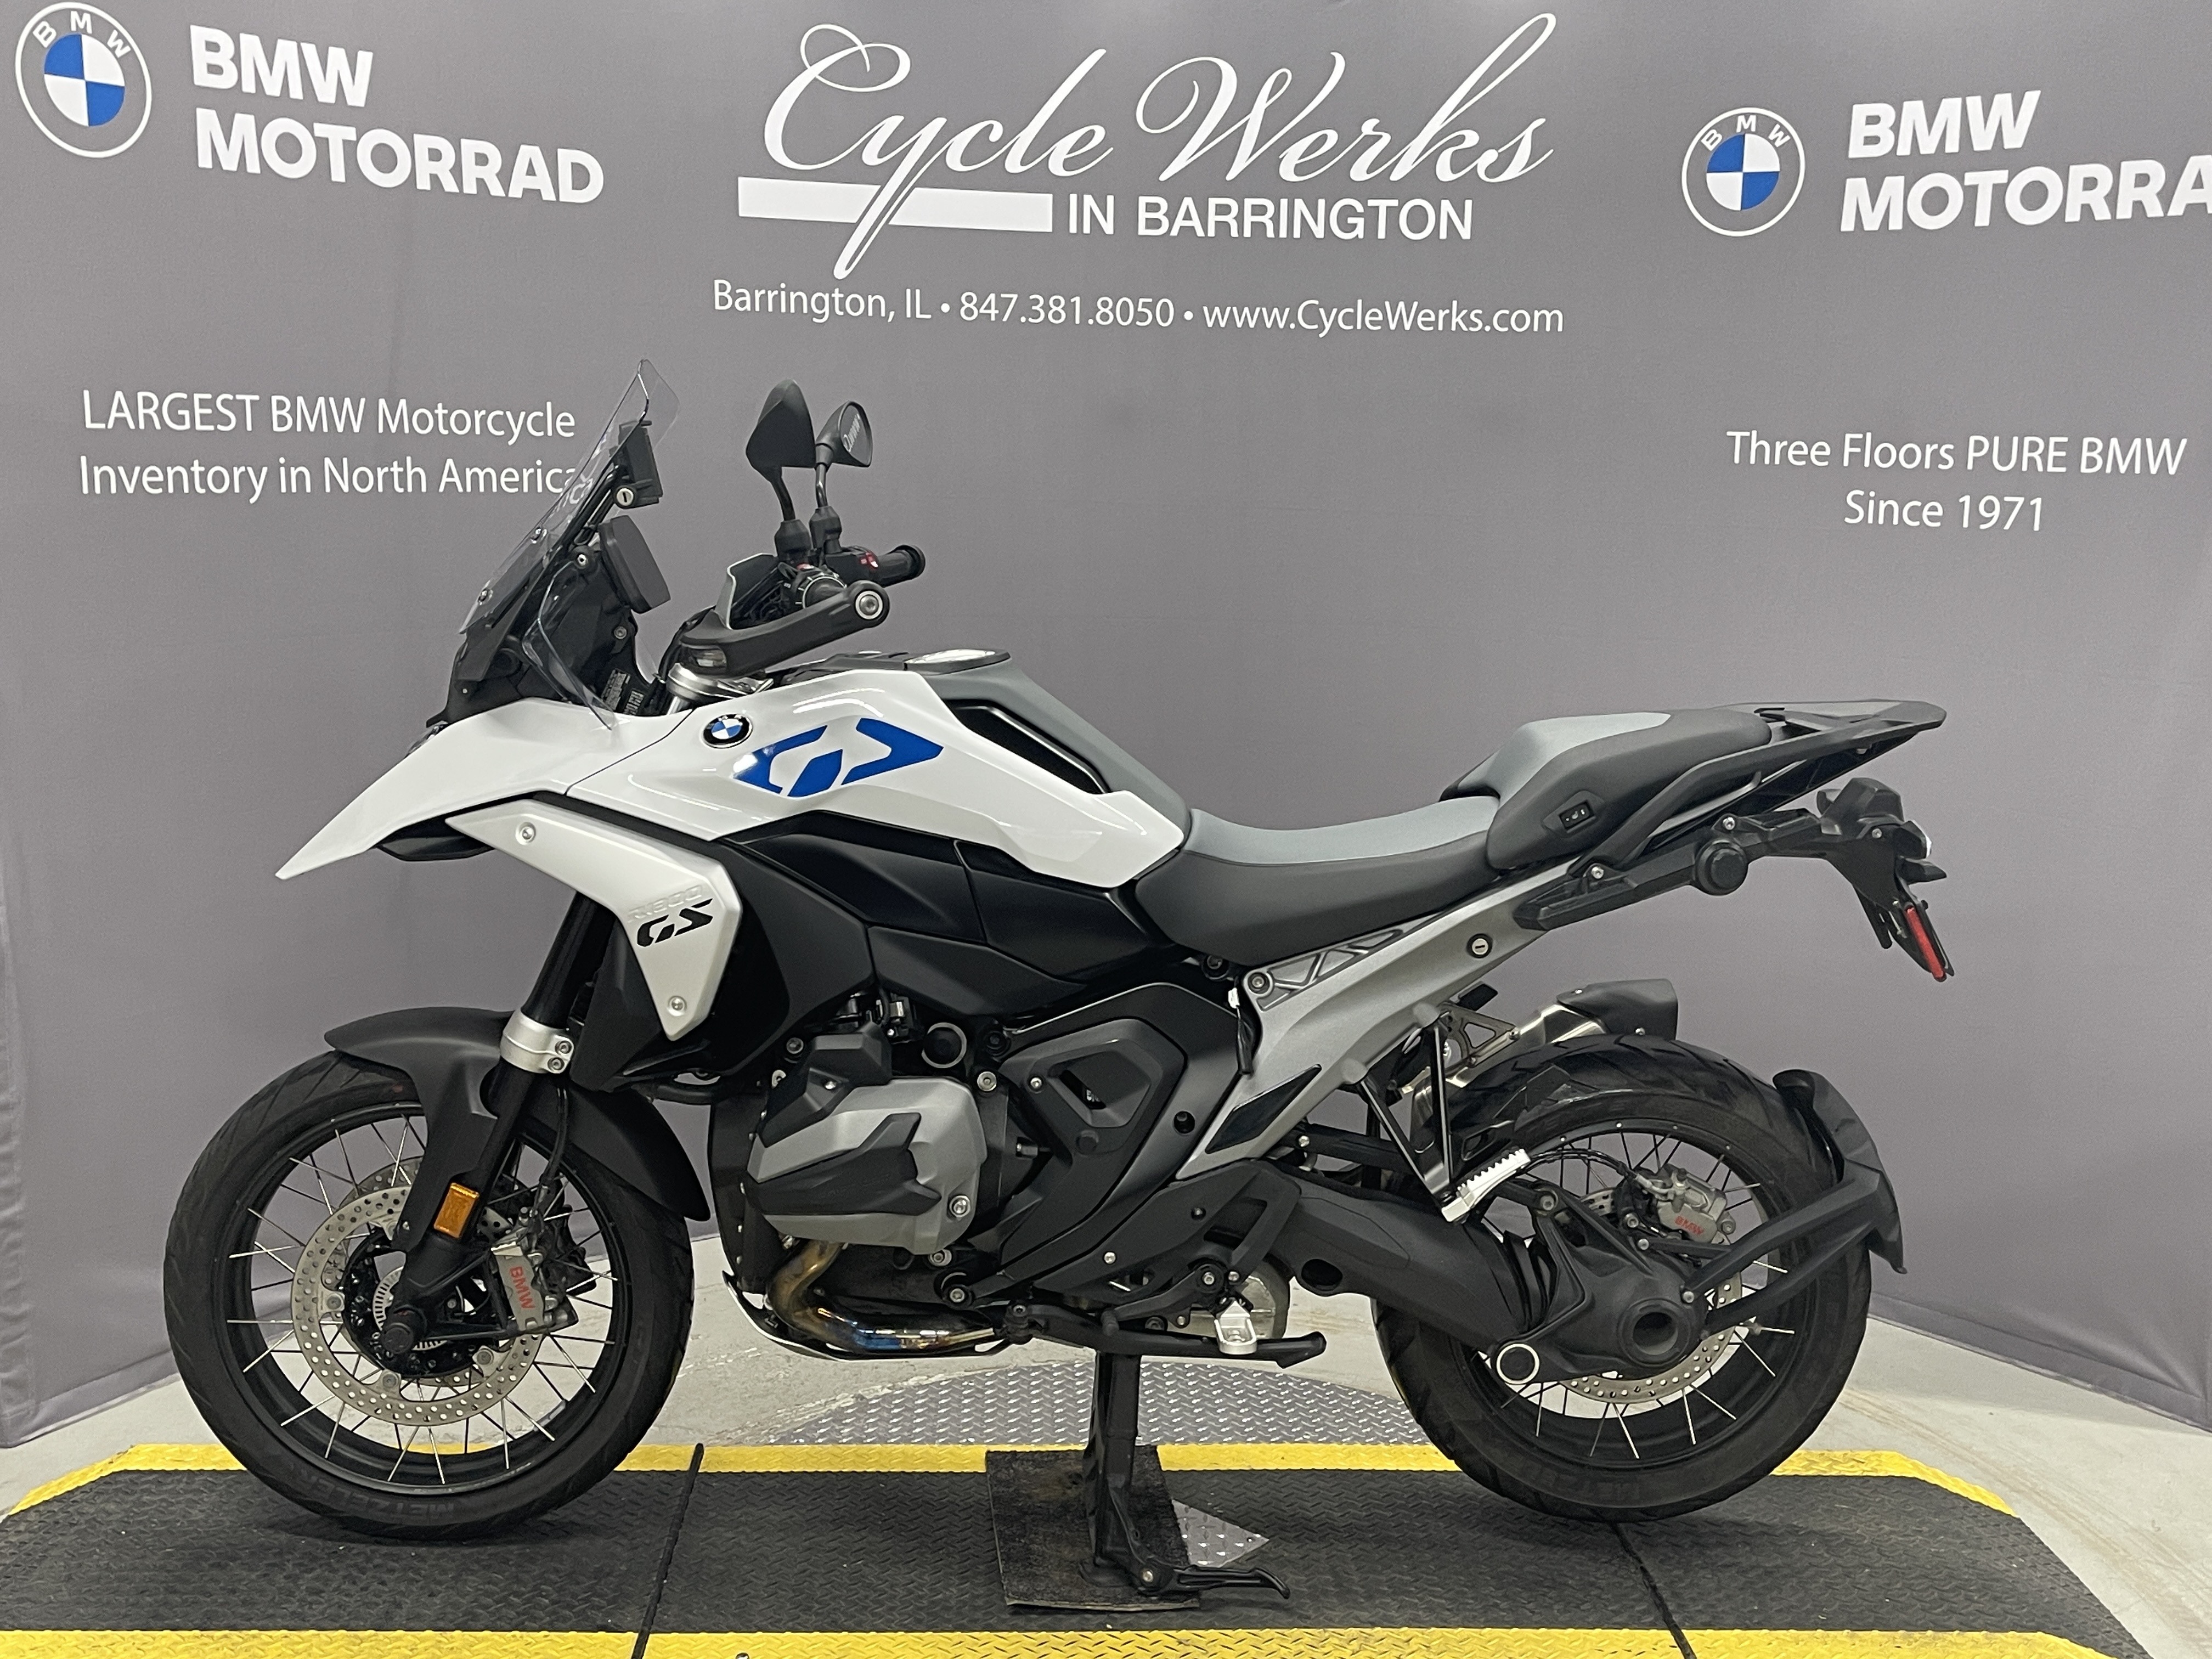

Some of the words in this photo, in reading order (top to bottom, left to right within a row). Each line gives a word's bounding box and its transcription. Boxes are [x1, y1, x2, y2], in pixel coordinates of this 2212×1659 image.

[32, 10, 132, 58] BMW
[190, 25, 374, 108] BMW
[764, 24, 1114, 280] Cycle
[1136, 13, 1556, 183] Werks
[1701, 115, 1791, 151] BMW
[1848, 90, 2041, 159] BMW
[196, 108, 604, 204] MOTORRAD
[1069, 194, 1114, 234] IN
[1138, 196, 1472, 240] BARRINGTON
[714, 279, 895, 323] Barrington,
[906, 289, 932, 319] IL
[960, 291, 1174, 327] 847.381.8050
[1203, 299, 1563, 338] www.CycleWerks.com
[83, 390, 259, 431] LARGEST
[271, 395, 366, 433] BMW
[378, 398, 575, 445] Motorcycle
[1726, 430, 1831, 466] Three
[1843, 432, 1954, 470] Floors
[1967, 435, 2068, 472] PURE
[2080, 437, 2187, 475] BMW
[81, 455, 268, 504] Inventory
[279, 457, 311, 493] in
[324, 456, 426, 493] North
[1844, 489, 1943, 527] Since
[1959, 495, 2042, 531] 1971
[637, 898, 713, 947] GS
[1674, 1215, 1704, 1235] BMW
[510, 1266, 536, 1308] BMW
